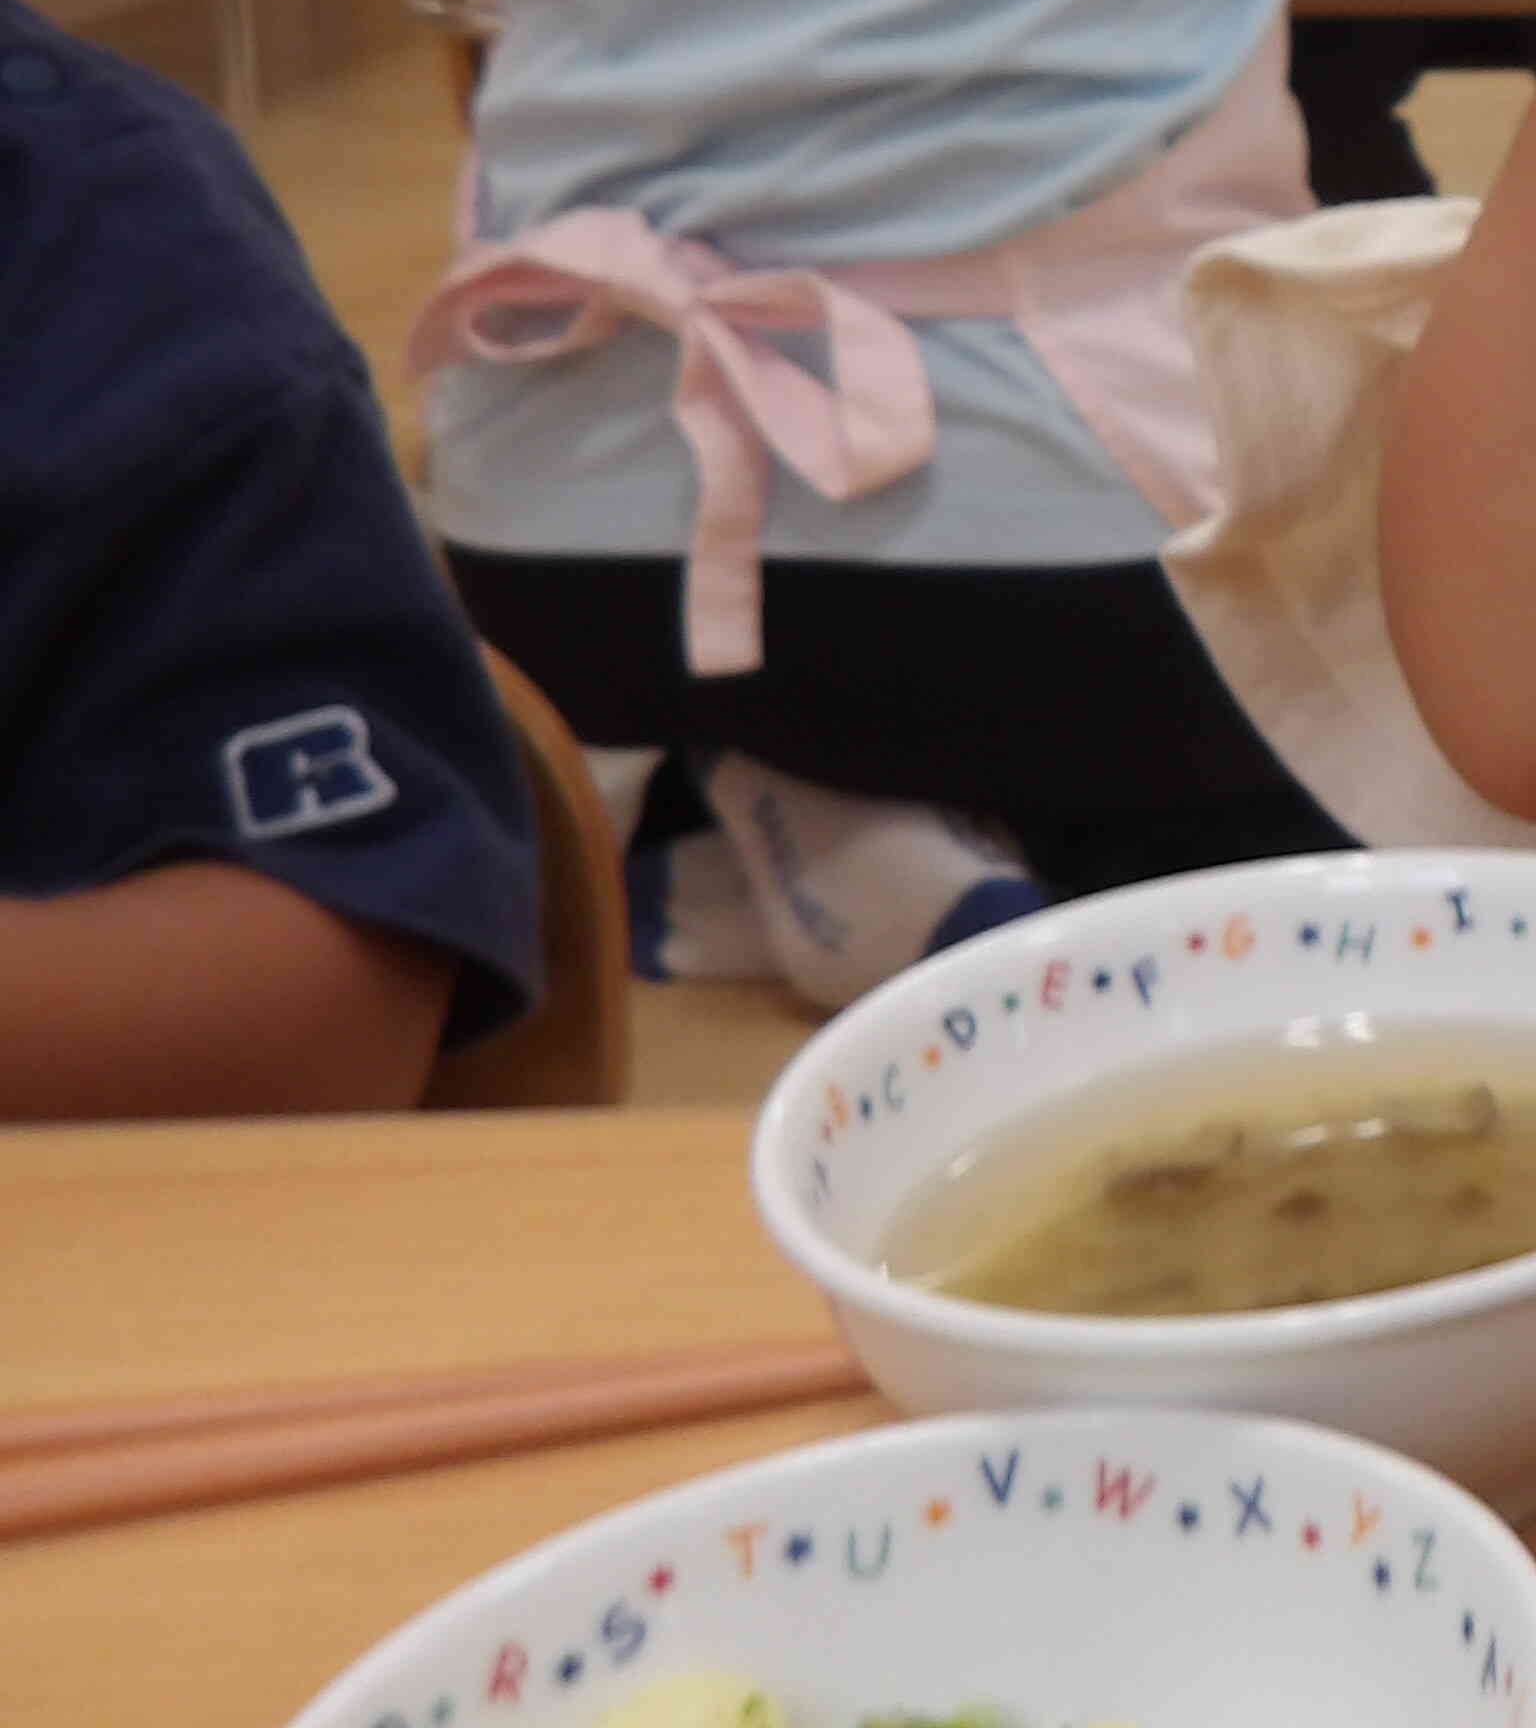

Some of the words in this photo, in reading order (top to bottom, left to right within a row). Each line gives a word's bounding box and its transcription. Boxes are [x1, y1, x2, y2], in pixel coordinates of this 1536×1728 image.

[942, 1007, 977, 1051] D
[1039, 959, 1073, 1012] E
[1334, 917, 1378, 964] H
[1444, 886, 1474, 934] I
[486, 1637, 531, 1705] R
[600, 1596, 648, 1667] S
[722, 1519, 773, 1580] T
[842, 1517, 895, 1581] U
[977, 1444, 1022, 1511] V
[1094, 1454, 1158, 1522] W
[1228, 1473, 1276, 1541] X
[1347, 1486, 1384, 1552] Y
[1409, 1524, 1443, 1595] Z
